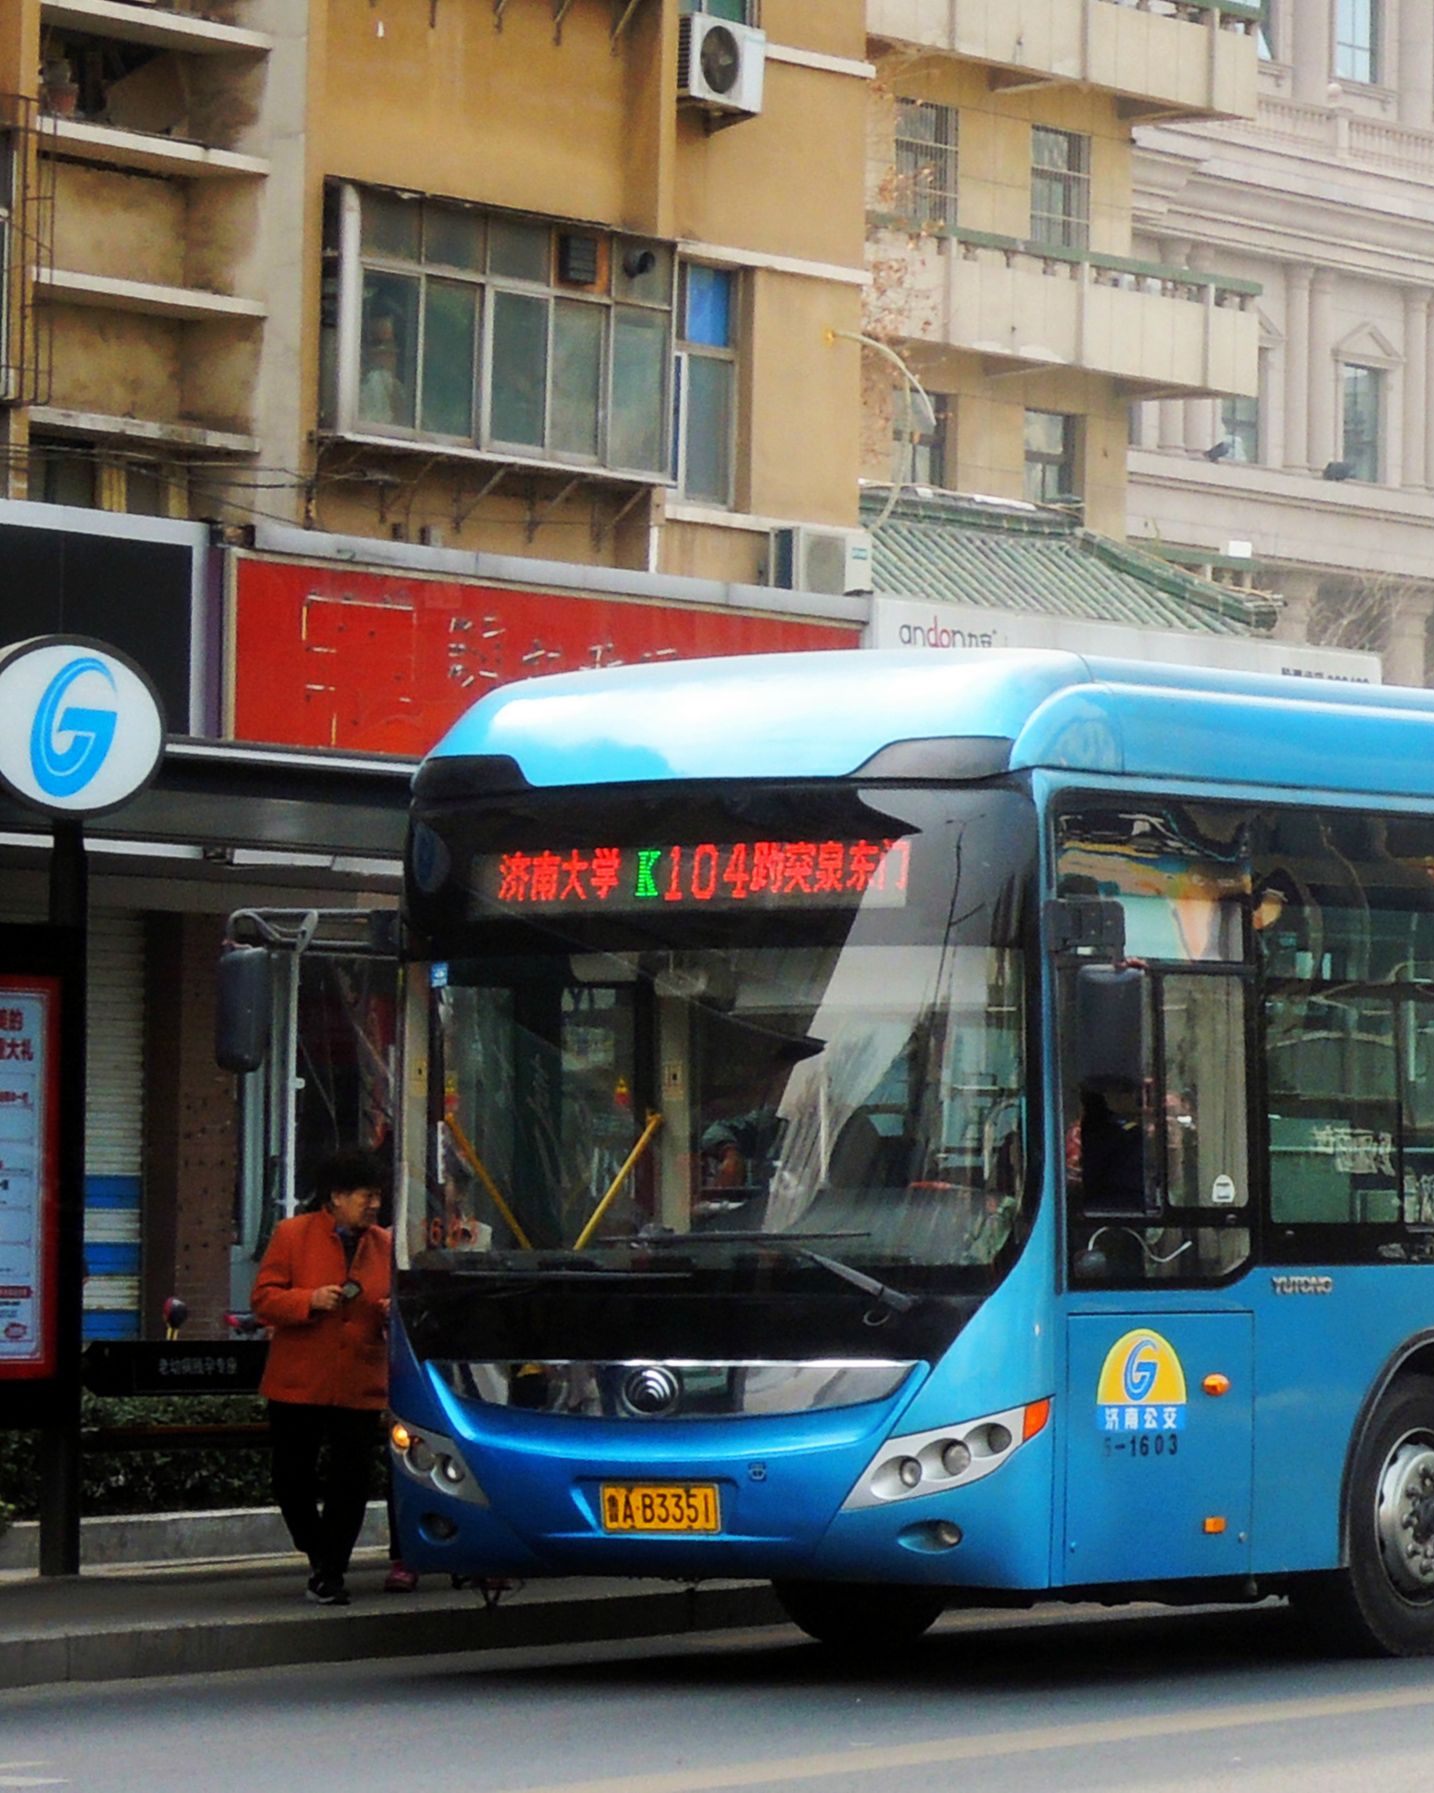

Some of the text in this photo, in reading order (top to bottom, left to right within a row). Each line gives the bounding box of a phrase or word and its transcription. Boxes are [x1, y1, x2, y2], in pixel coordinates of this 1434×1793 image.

[899, 615, 966, 648] andon
[498, 848, 621, 901] 济南大学
[1104, 1406, 1178, 1431] 济南公交
